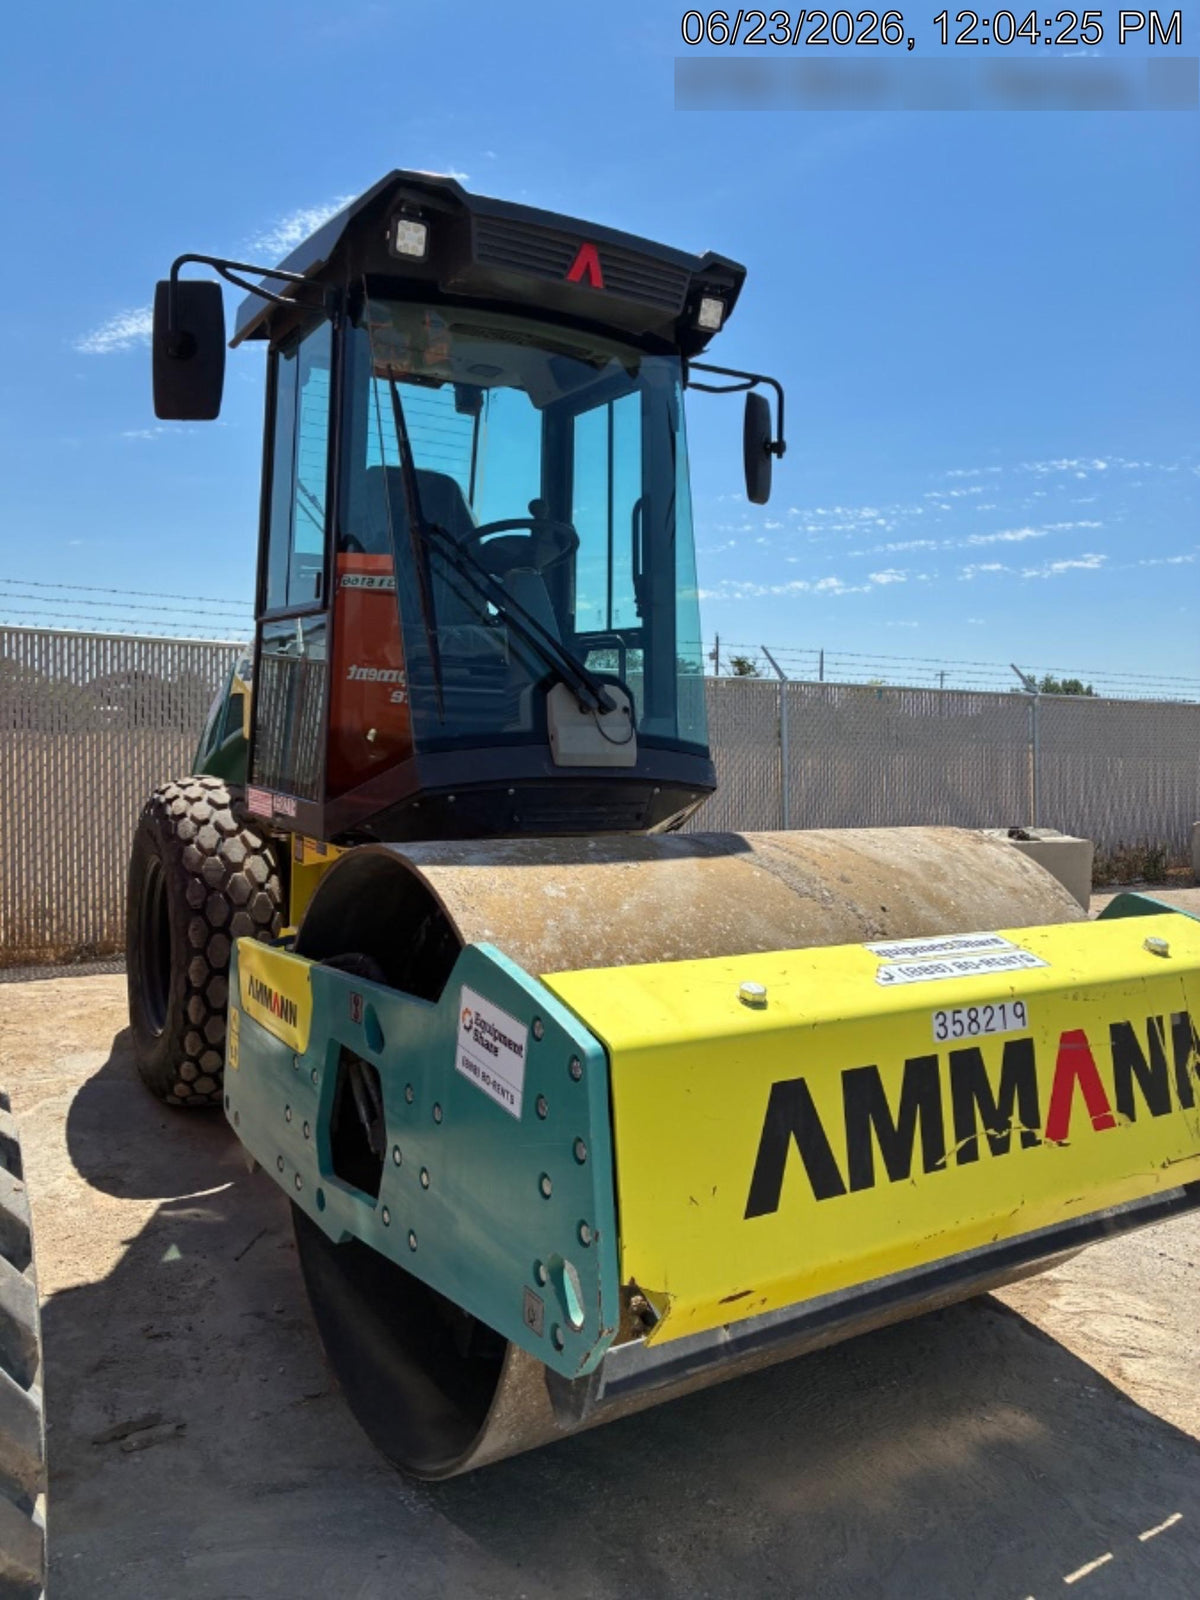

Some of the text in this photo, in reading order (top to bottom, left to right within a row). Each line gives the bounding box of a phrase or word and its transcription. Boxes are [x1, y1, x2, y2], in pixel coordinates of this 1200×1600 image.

[247, 974, 298, 1029] AMMANN
[934, 1000, 1028, 1041] 358219
[472, 1028, 499, 1058] Share
[473, 1011, 524, 1059] Equipment
